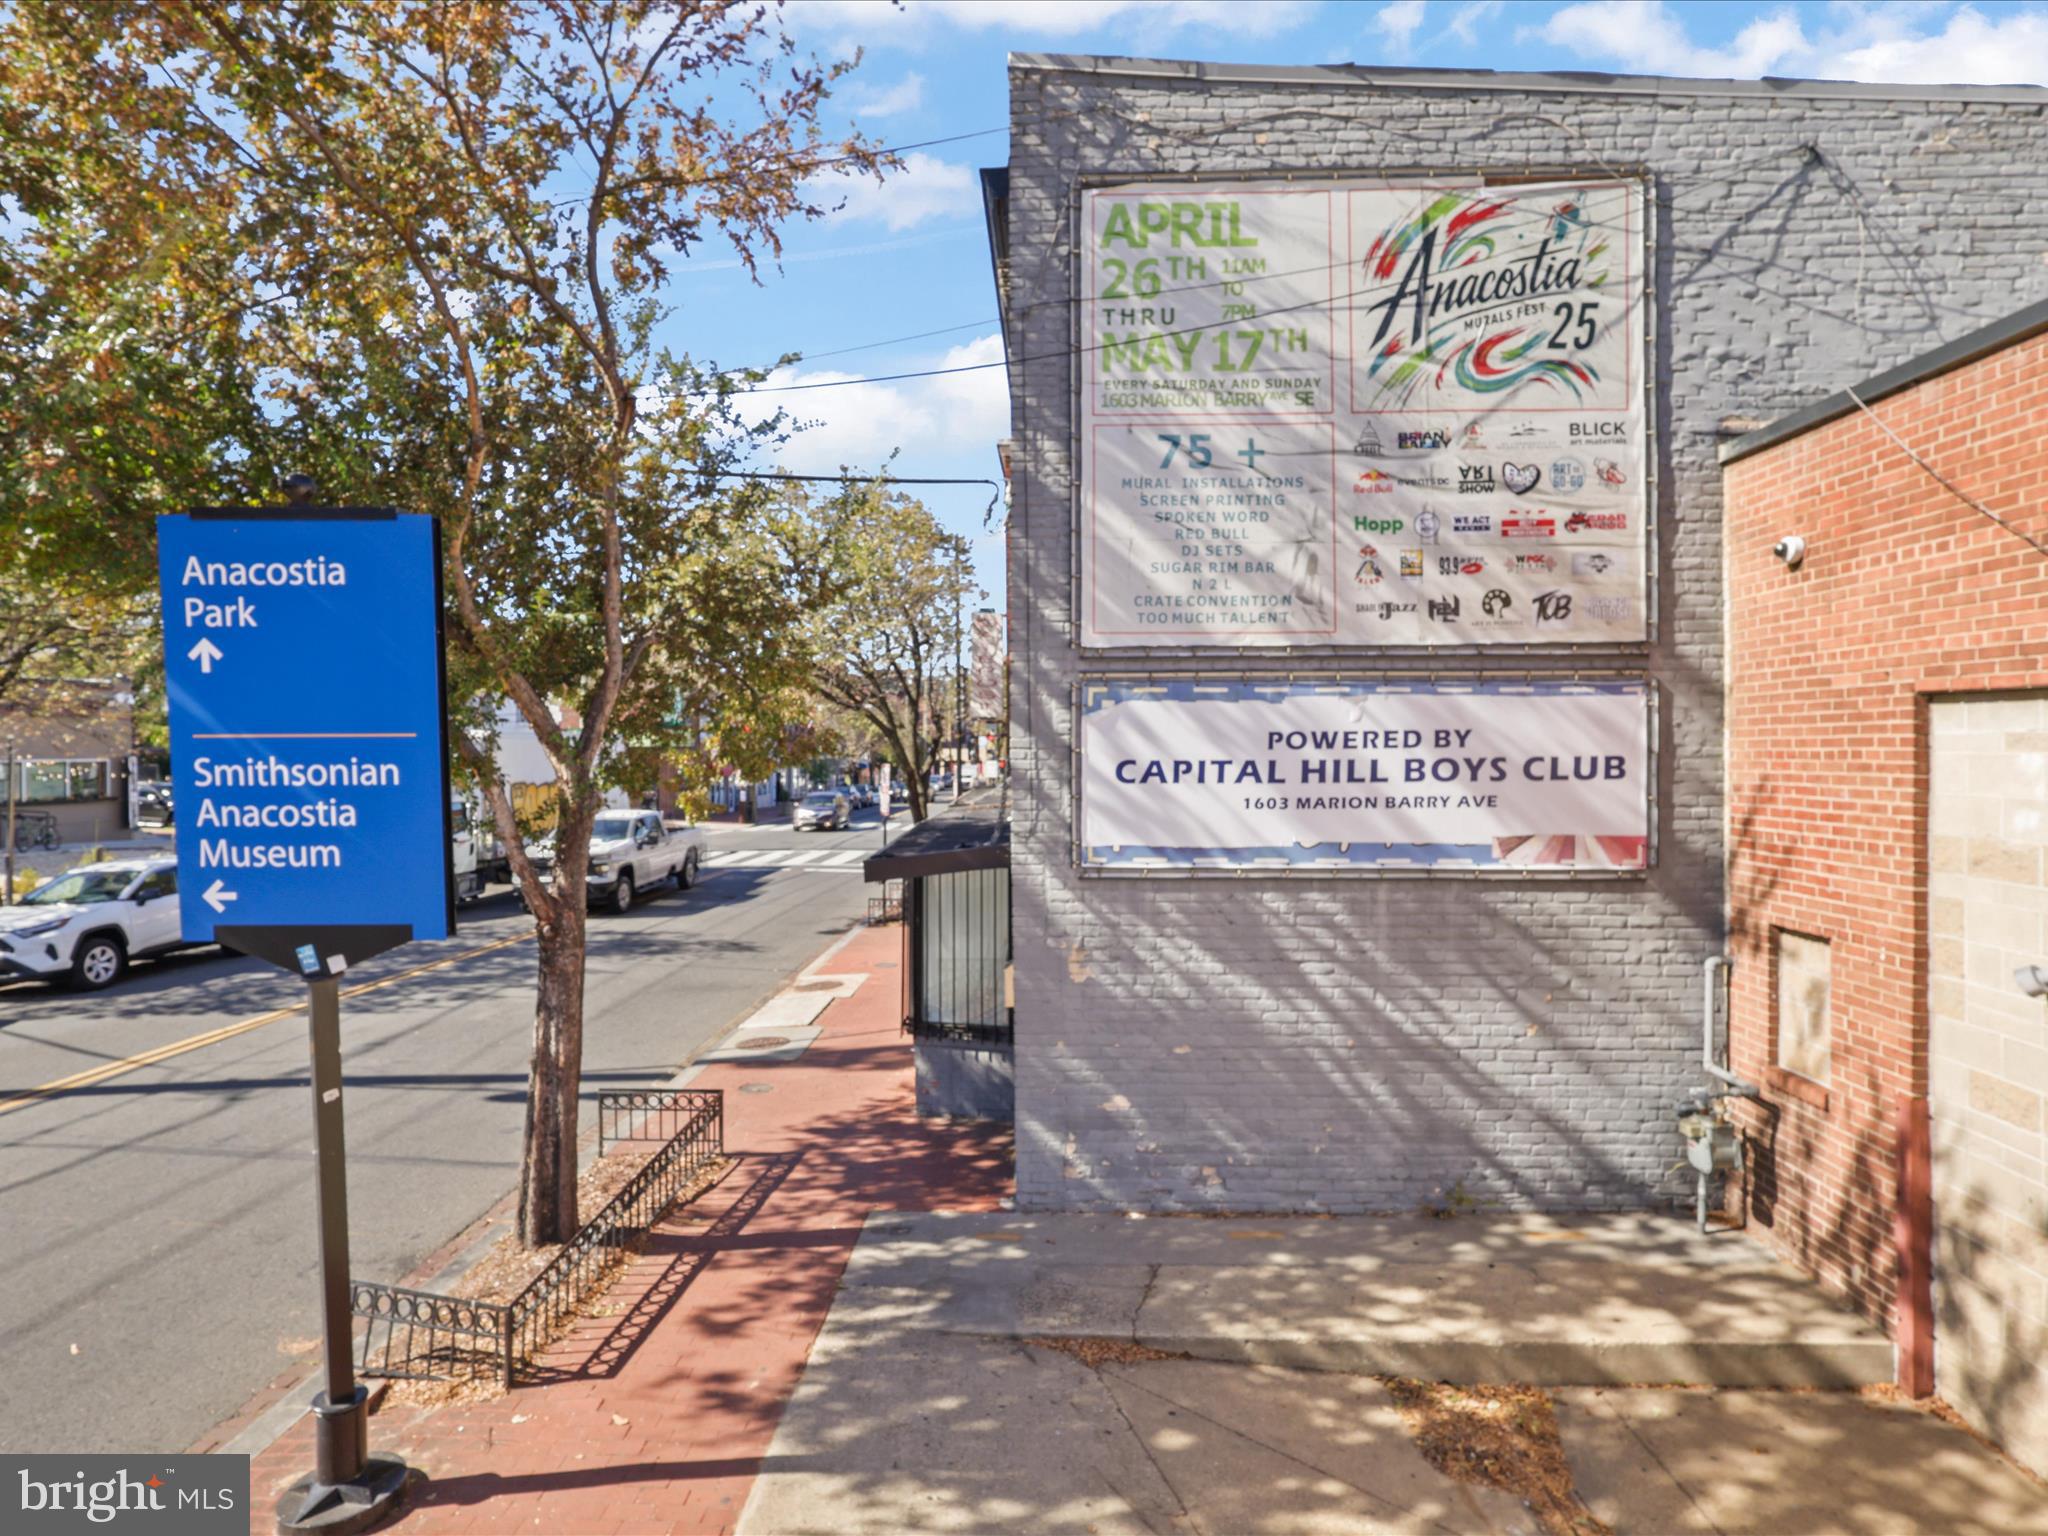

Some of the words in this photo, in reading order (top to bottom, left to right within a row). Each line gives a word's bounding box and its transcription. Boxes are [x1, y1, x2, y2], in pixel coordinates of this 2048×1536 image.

[1100, 201, 1258, 248] APRIL
[1221, 258, 1266, 274] 11AM
[1101, 256, 1207, 300] 26TH
[1222, 281, 1245, 296] TO
[1366, 225, 1585, 350] Anacostia
[1103, 308, 1175, 325] THRU
[1221, 304, 1257, 320] 7PM
[1517, 302, 1546, 317] FEST
[1548, 302, 1600, 350] 25
[1102, 331, 1204, 373] MAY
[1210, 328, 1308, 373] 17TH
[1104, 379, 1146, 391] EVERY
[1152, 378, 1227, 391] SATURDAY
[1231, 378, 1260, 390] AND
[1265, 377, 1322, 390] SUNDAY
[1101, 393, 1138, 408] 1603
[1140, 392, 1207, 408] MARION
[1214, 391, 1268, 407] BARRY
[1294, 391, 1315, 407] SE
[1569, 422, 1626, 436] BLICK
[1158, 434, 1213, 470] 75
[1121, 477, 1172, 489] MURAL
[1182, 476, 1304, 489] INSTALLATIONS
[1353, 484, 1373, 493] Red
[1374, 484, 1393, 493] Bull
[1458, 484, 1495, 493] SHOW
[1140, 494, 1199, 507] SCREEN
[1206, 493, 1285, 506] PRINTING
[1154, 511, 1216, 523] SPOKEN
[1223, 510, 1270, 522] WORD
[1454, 516, 1467, 524] WE
[1472, 516, 1490, 524] ACT
[1175, 528, 1205, 540] RED
[1211, 527, 1249, 539] BULL
[1355, 516, 1404, 535] Hopp
[1182, 545, 1199, 556] DJ
[1205, 545, 1243, 556] SETS
[182, 555, 346, 586] Anacostia
[1151, 562, 1203, 574] SUGAR
[1209, 562, 1238, 573] RIM
[1245, 561, 1276, 573] BAR
[1193, 579, 1202, 590] N
[1209, 579, 1217, 590] 2
[1225, 579, 1232, 590] L
[1134, 596, 1184, 607] CRATE
[1187, 595, 1292, 607] CONVENTION
[185, 596, 258, 628] Park
[1137, 612, 1168, 624] TOO
[1171, 612, 1215, 624] MUCH
[1221, 611, 1290, 624] TALLENT
[1378, 602, 1419, 620] Jazz
[1268, 729, 1423, 751] POWERED
[1434, 728, 1473, 749] BY
[194, 756, 400, 788] Smithsonian
[1115, 759, 1286, 784] CAPITAL
[1301, 757, 1389, 784] HILL
[1404, 756, 1508, 783] BOYS
[1523, 754, 1627, 781] CLUB
[1244, 796, 1290, 811] 1603
[1296, 795, 1378, 811] MARION
[1385, 795, 1452, 810] BARRY
[1457, 794, 1499, 809] AVE
[197, 797, 357, 828] Anacostia
[200, 838, 341, 869] Museum
